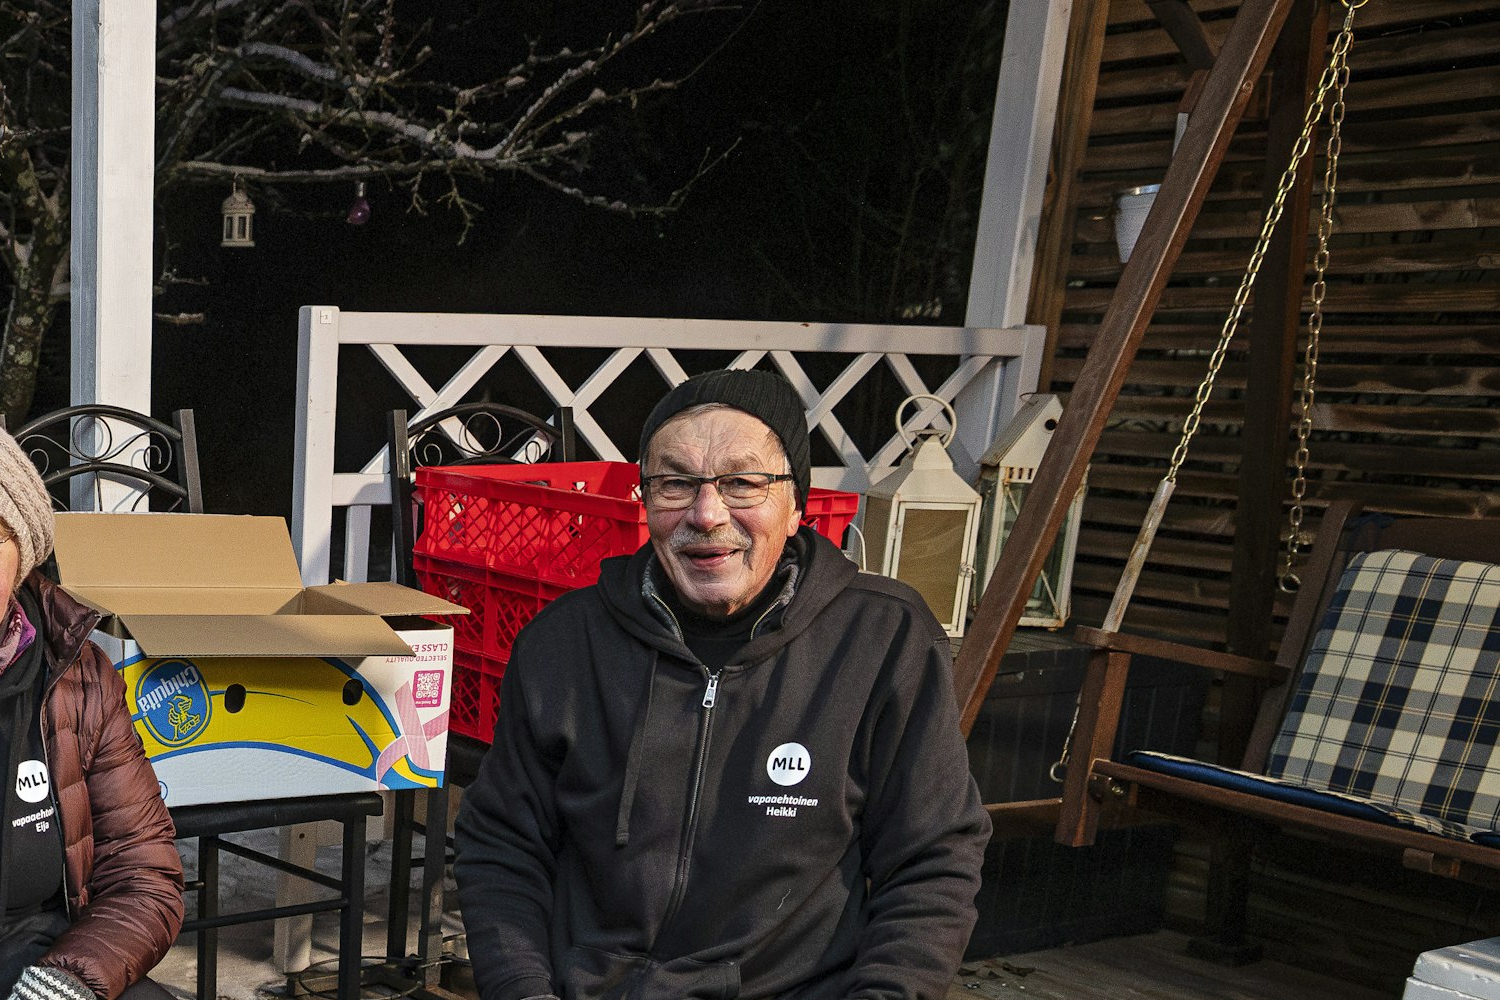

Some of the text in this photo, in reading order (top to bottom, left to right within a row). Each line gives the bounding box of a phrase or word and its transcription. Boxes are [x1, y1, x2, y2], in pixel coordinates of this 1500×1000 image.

[421, 643, 448, 653] CLASS
[385, 654, 448, 664] SELECTED QUALITY
[137, 665, 200, 713] Chiquita
[772, 757, 805, 771] MLL
[18, 771, 47, 791] MLL
[748, 794, 819, 807] vapaaehtoinen
[766, 807, 798, 818] Heikki
[35, 820, 50, 833] Eija
